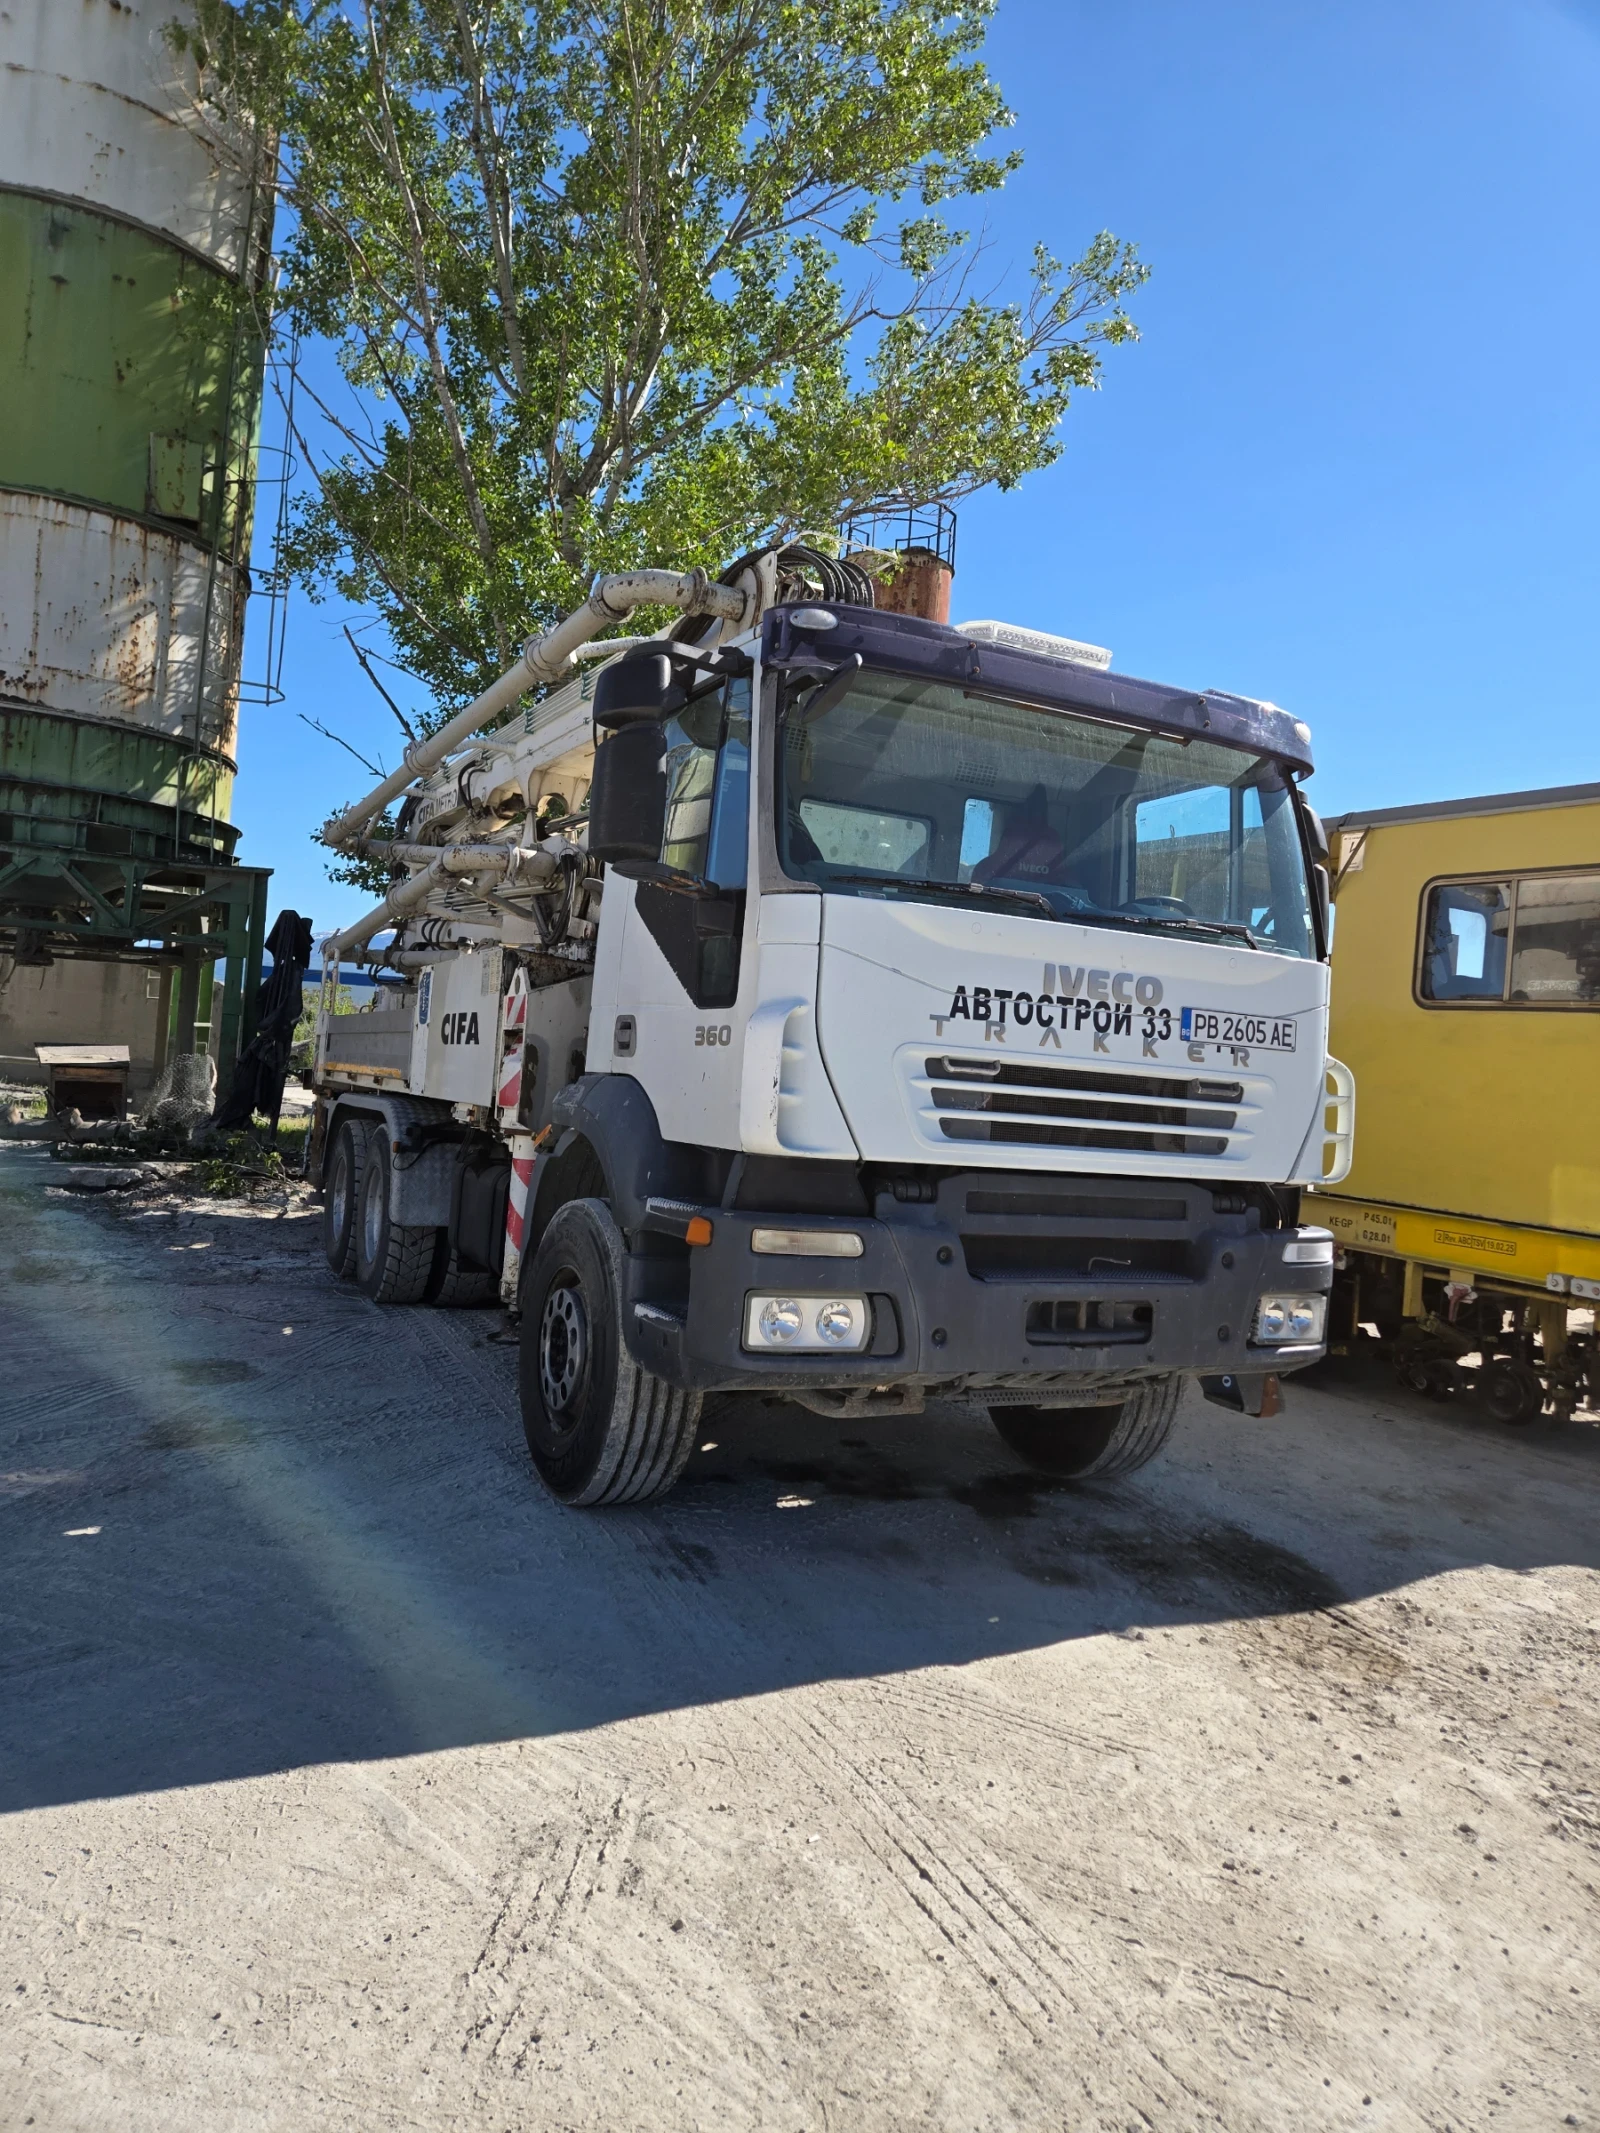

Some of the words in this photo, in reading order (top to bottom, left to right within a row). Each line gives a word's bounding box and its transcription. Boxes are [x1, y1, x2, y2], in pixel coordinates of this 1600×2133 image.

[418, 801, 435, 825] CIFA
[1018, 861, 1050, 875] IVECO
[1042, 962, 1164, 1007] IVECO
[949, 985, 1132, 1037] АВТОСТРОЙ
[1141, 1006, 1173, 1041] 33
[441, 1012, 480, 1046] CIFA
[694, 1024, 732, 1047] 360
[929, 1013, 1251, 1068] TRAKKER
[1181, 1028, 1191, 1037] BG
[1222, 1017, 1267, 1044] 2605
